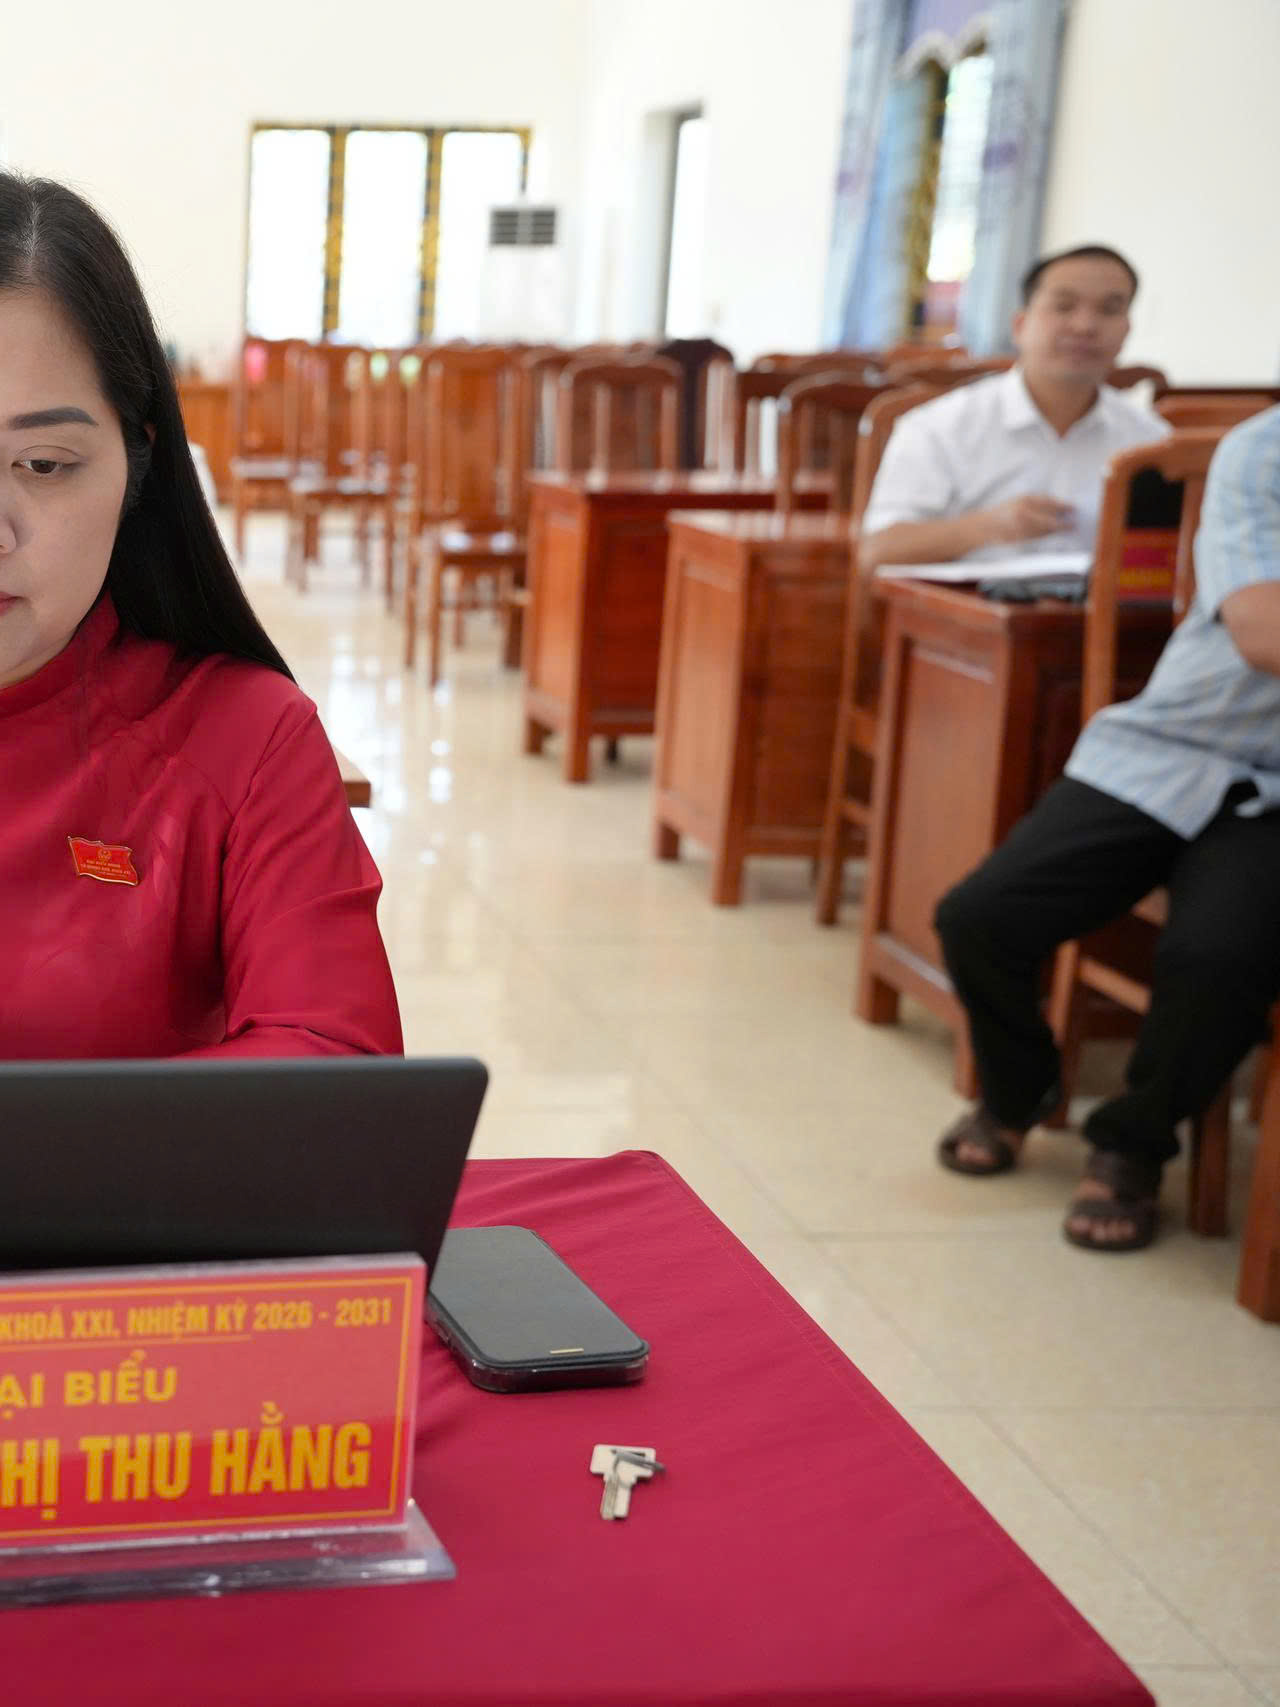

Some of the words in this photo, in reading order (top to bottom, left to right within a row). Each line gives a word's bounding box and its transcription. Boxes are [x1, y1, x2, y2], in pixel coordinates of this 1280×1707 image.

[127, 1300, 208, 1341] NHIỆM
[215, 1297, 248, 1334] KỲ
[252, 1300, 312, 1331] 2026
[334, 1298, 392, 1327] 2031
[64, 1348, 179, 1408] BIỂU
[79, 1432, 192, 1503] THU
[210, 1400, 372, 1496] HẰNG
